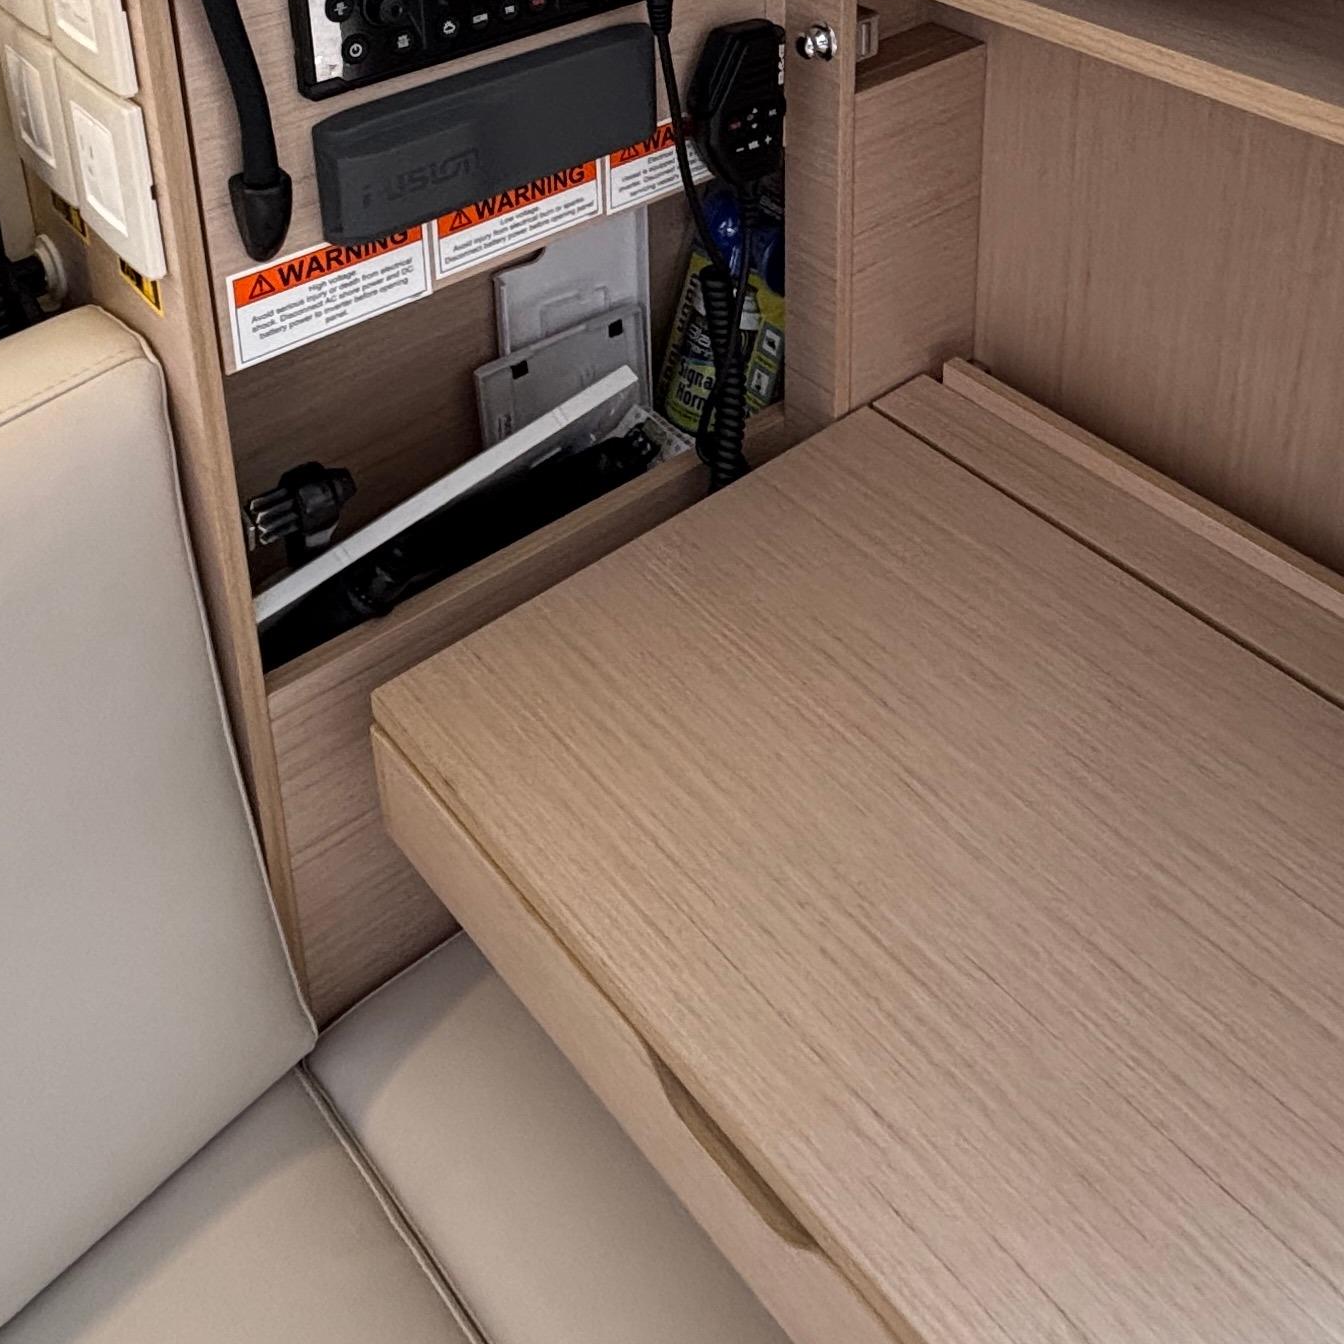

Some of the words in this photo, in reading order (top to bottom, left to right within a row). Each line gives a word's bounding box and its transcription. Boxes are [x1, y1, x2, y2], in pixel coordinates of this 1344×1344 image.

[473, 165, 586, 220] WARNING
[277, 231, 409, 287] WARNING
[251, 311, 275, 325] Avoid
[279, 300, 324, 323] Disconnect
[678, 358, 715, 390] Signa
